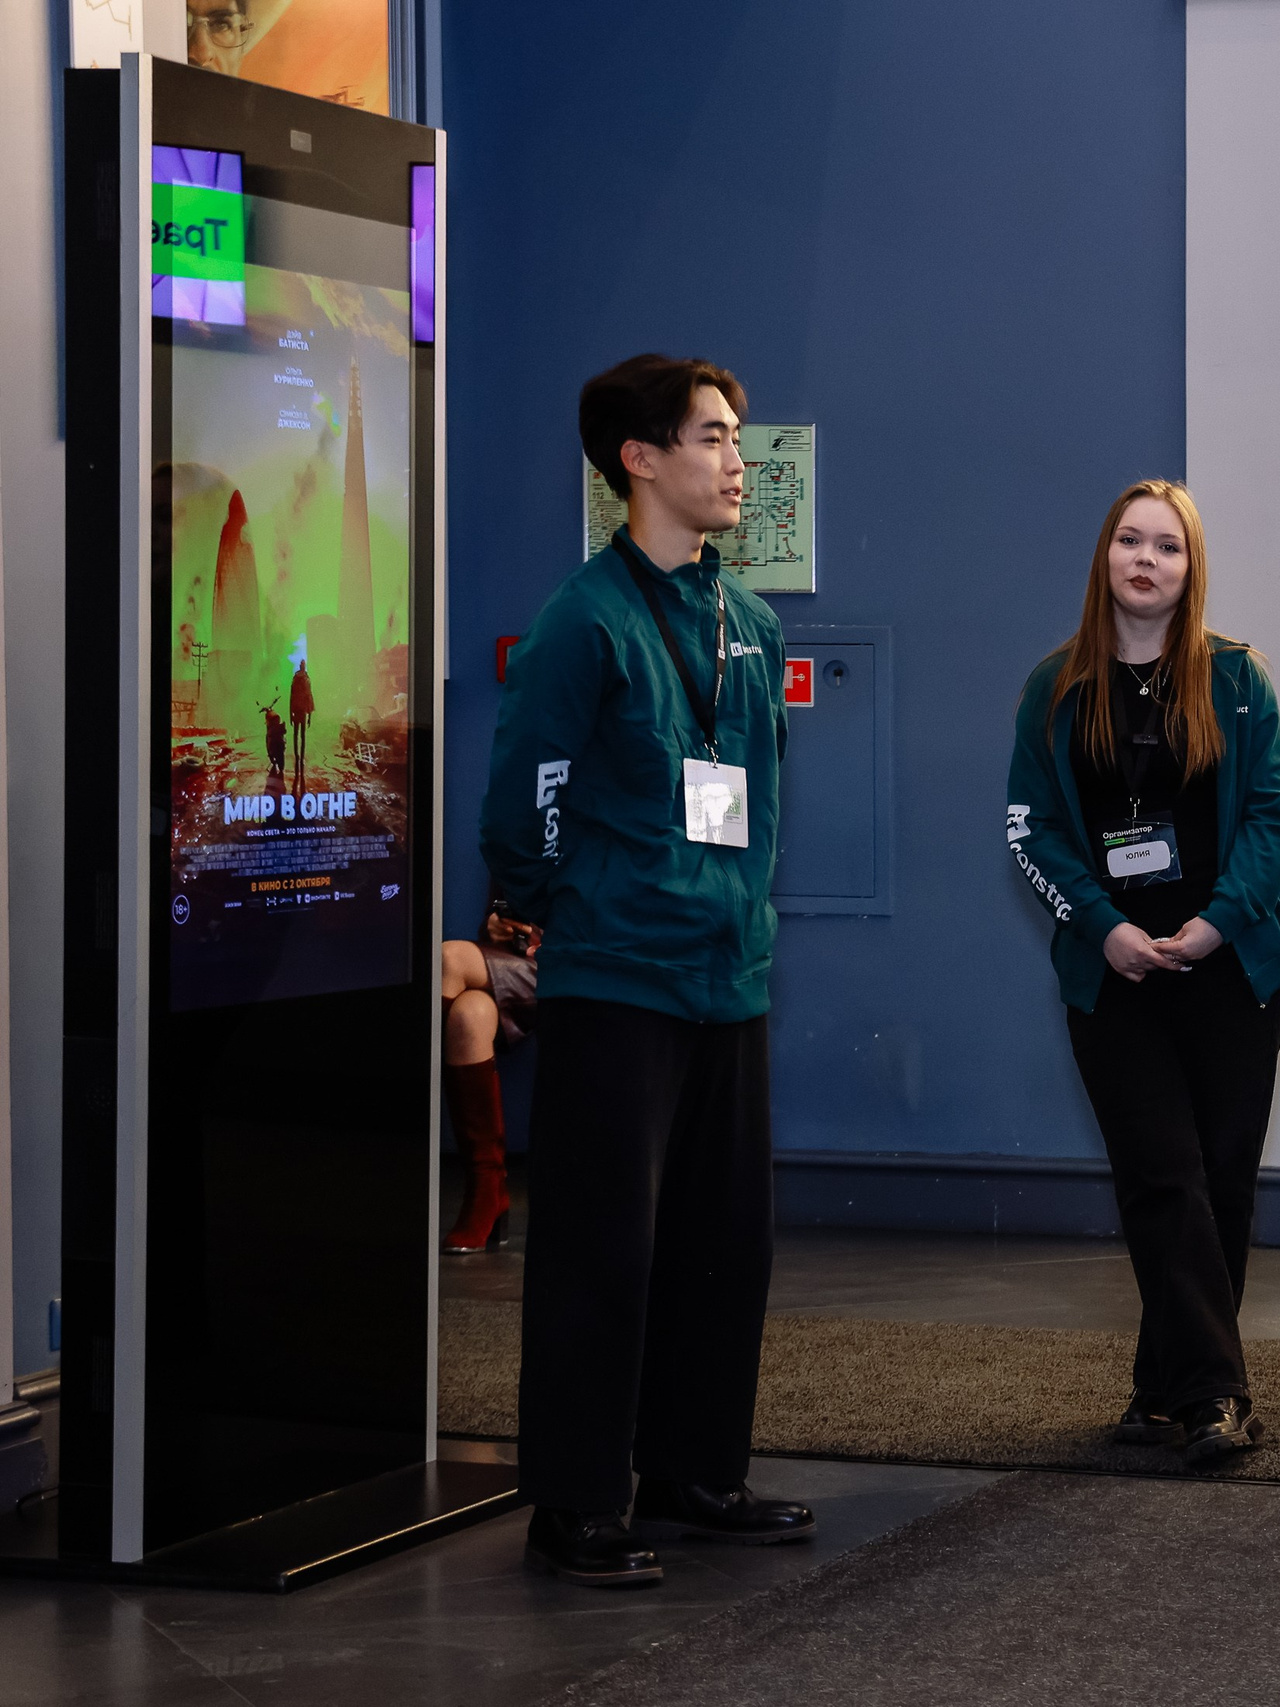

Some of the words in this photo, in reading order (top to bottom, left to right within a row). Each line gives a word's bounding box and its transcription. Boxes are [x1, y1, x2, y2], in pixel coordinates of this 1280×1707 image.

[279, 338, 310, 351] БАТИСТА
[273, 374, 315, 387] КУРИЛЕНКО
[224, 795, 275, 824] МИР
[281, 794, 296, 820] В
[300, 792, 356, 820] ОГНЕ
[246, 829, 264, 837] КОНЕЦ
[265, 828, 280, 836] СВЕТА
[316, 825, 336, 833] НАЧАЛО
[1102, 825, 1153, 839] Организатор
[1125, 850, 1151, 860] ЮЛИЯ
[251, 882, 257, 892] В
[258, 880, 281, 891] КИНО
[282, 880, 288, 889] С
[290, 879, 295, 888] 2
[296, 877, 331, 888] ОКТЯБРЯ
[175, 904, 188, 915] 18+
